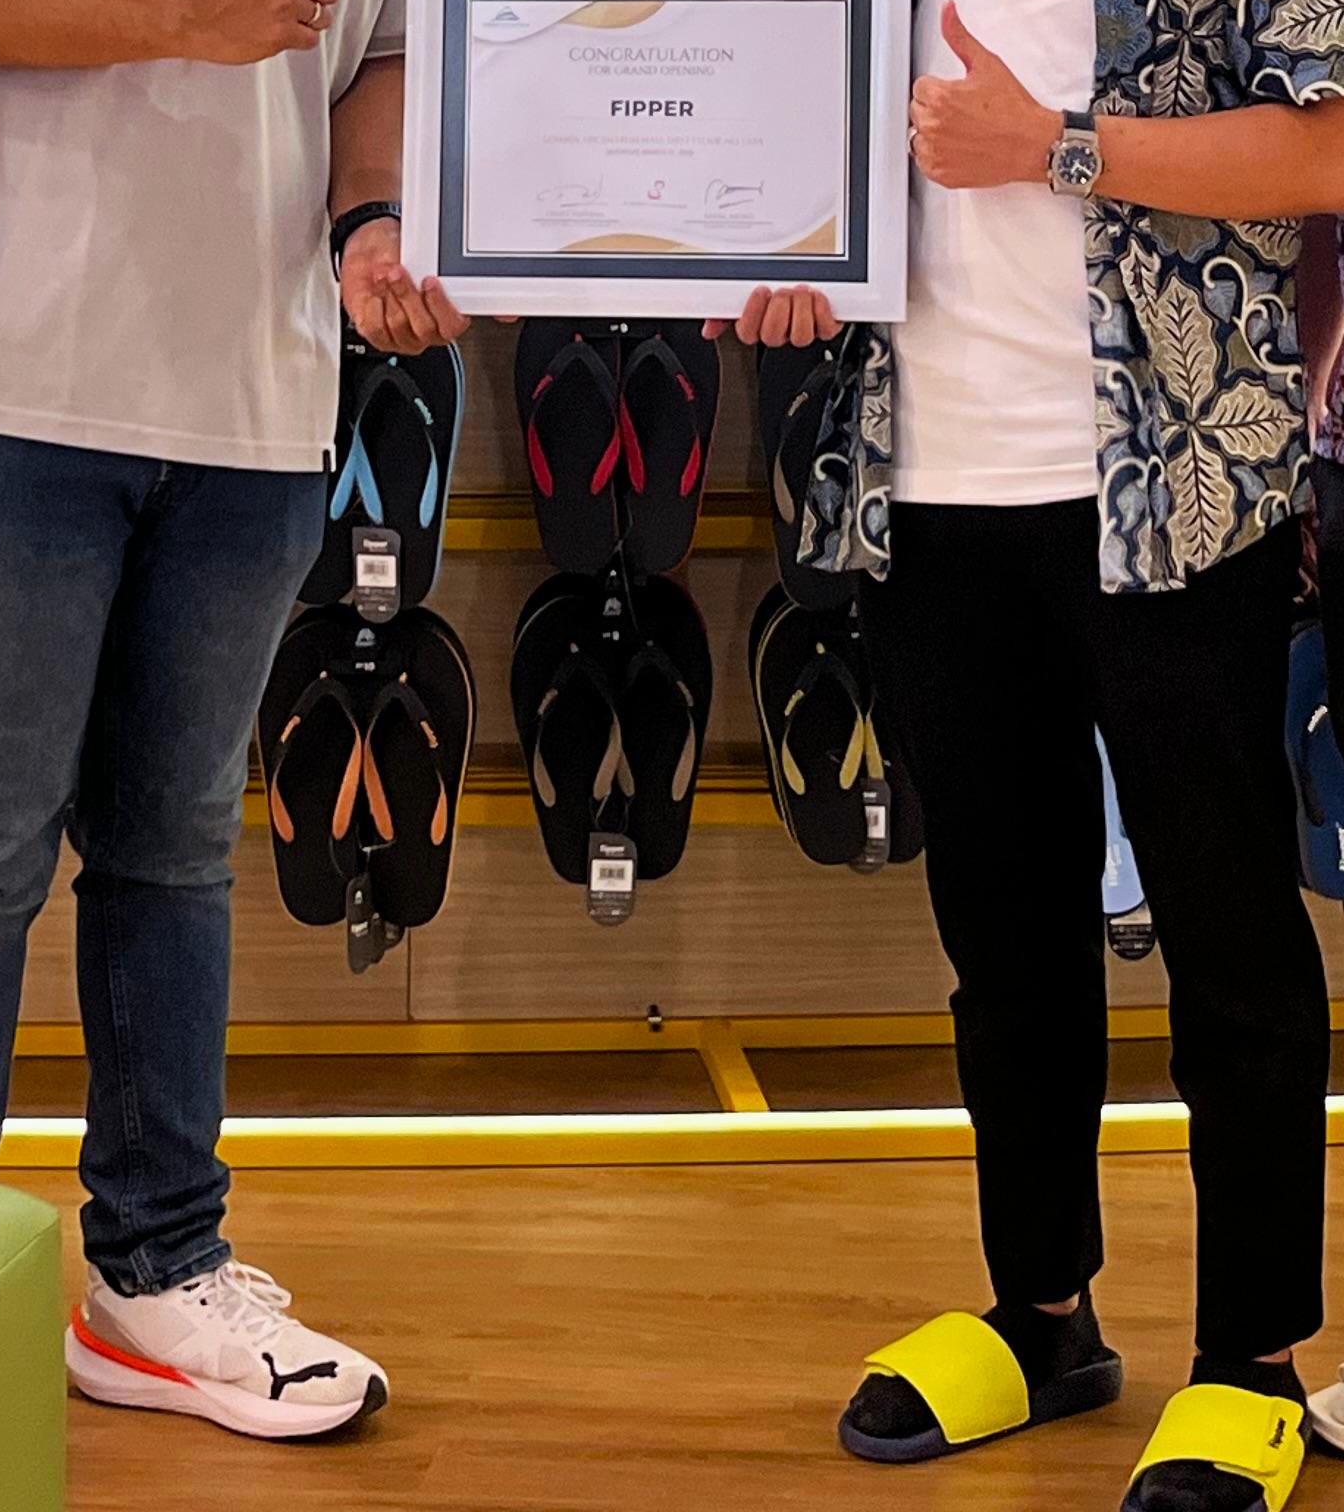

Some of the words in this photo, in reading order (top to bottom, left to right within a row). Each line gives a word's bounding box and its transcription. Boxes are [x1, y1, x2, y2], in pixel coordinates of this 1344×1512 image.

[569, 47, 734, 62] CONGRATULATION
[588, 66, 612, 76] FOR
[610, 100, 694, 117] FIPPER
